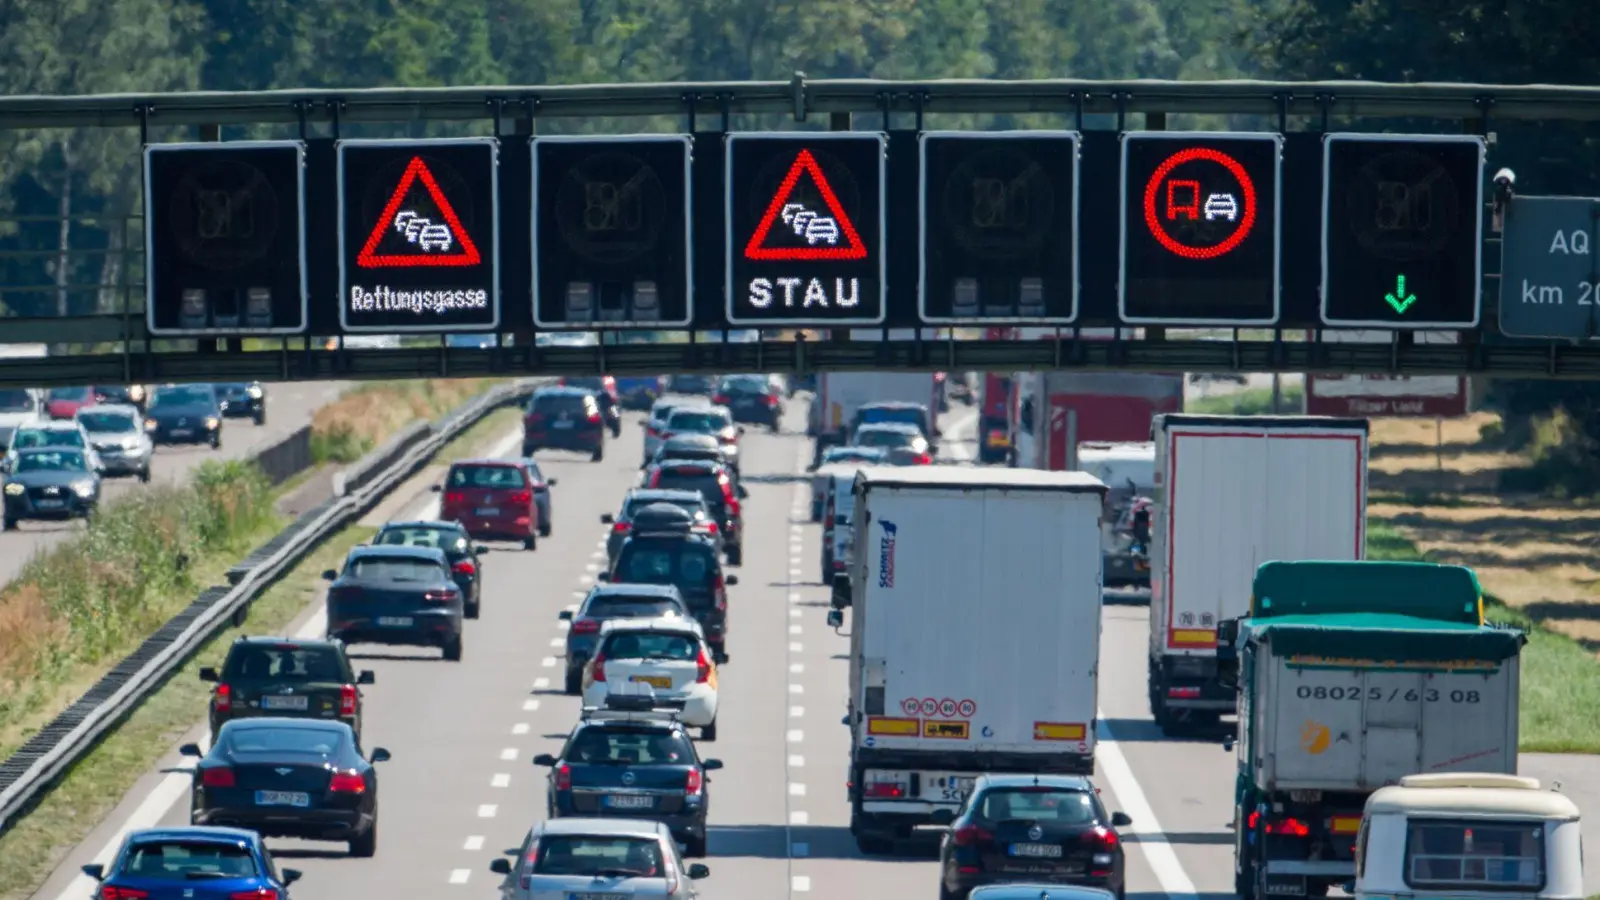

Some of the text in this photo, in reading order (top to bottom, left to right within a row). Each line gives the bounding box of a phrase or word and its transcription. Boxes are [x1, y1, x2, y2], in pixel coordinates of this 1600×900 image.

[1549, 229, 1590, 255] AQ
[351, 284, 488, 315] Rettungsgasse
[748, 277, 859, 308] STAU
[1522, 278, 1563, 305] km
